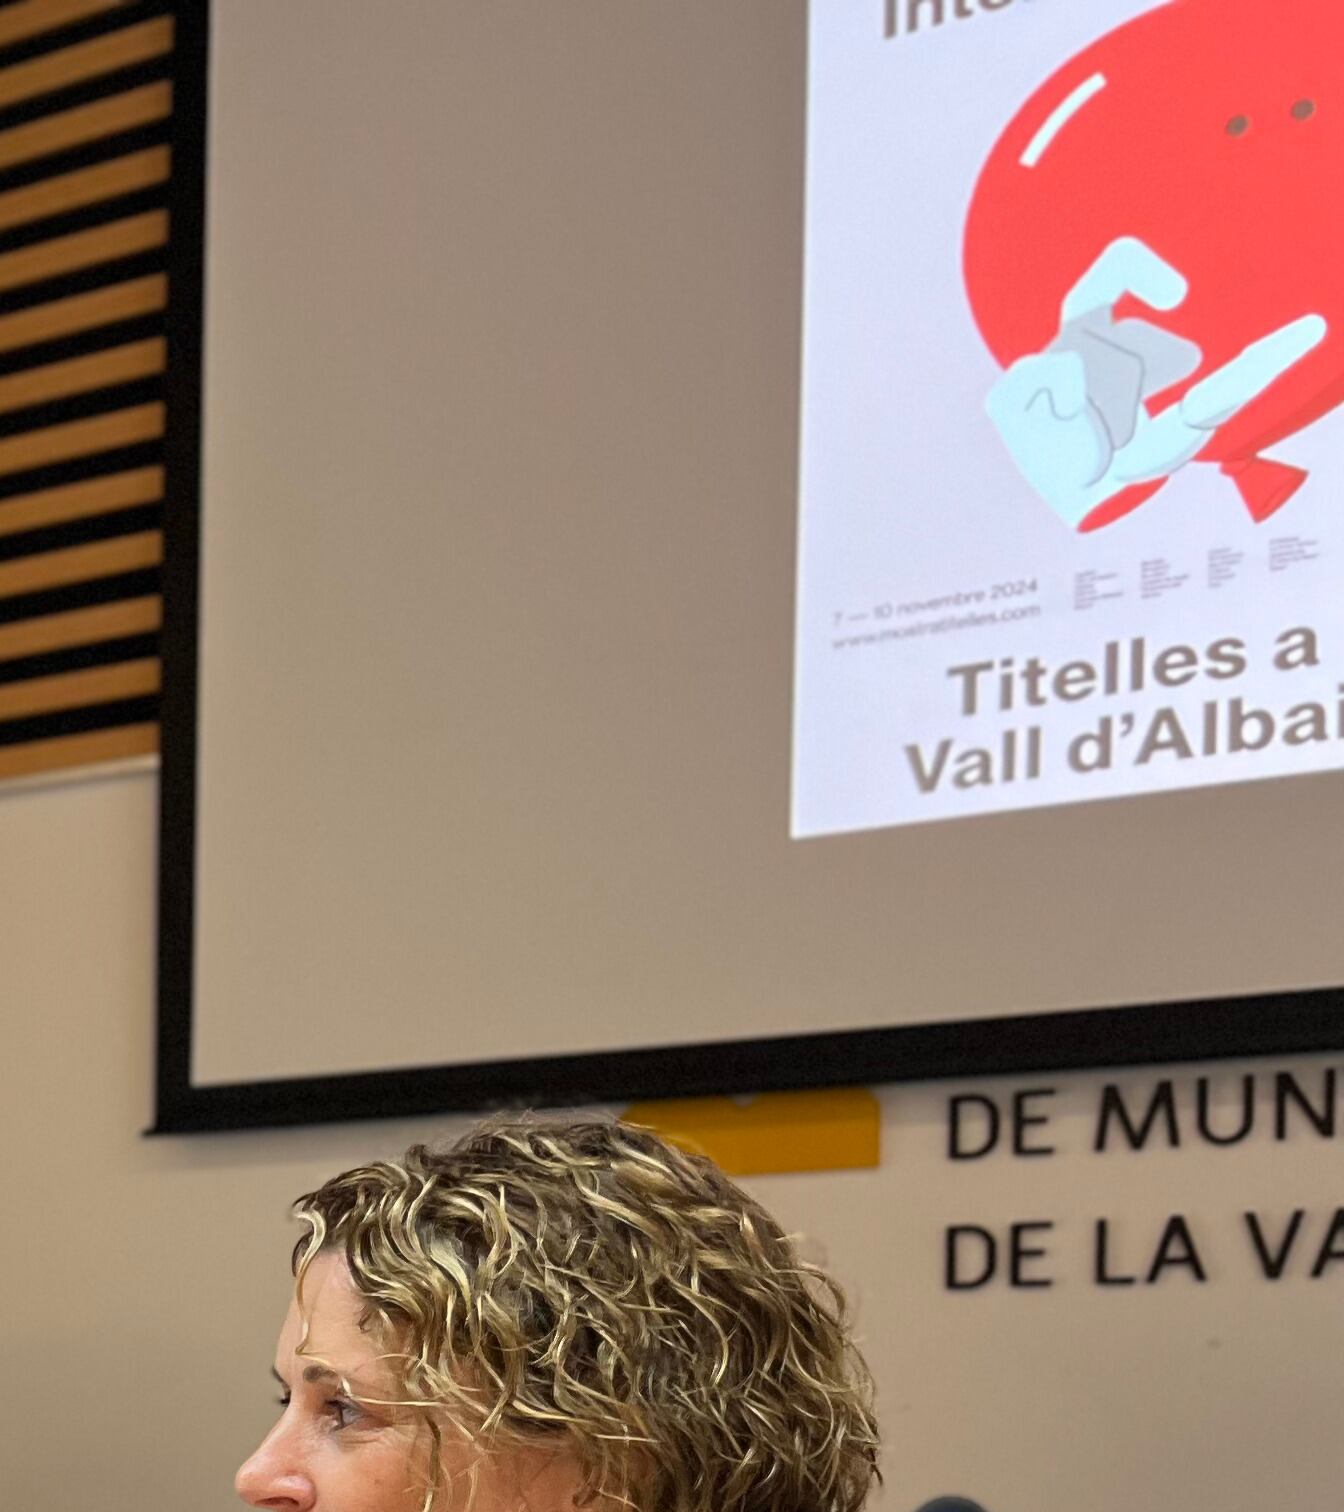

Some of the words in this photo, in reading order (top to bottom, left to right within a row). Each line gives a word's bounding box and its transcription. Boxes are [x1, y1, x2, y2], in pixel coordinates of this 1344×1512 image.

[874, 602, 893, 620] 10
[896, 588, 986, 616] novembre
[990, 577, 1038, 601] 2024
[946, 636, 1247, 716] Titelles
[1272, 626, 1320, 672] a
[904, 725, 1042, 794] Vall
[948, 1088, 1056, 1160] DE
[1094, 1067, 1337, 1153] MUN
[945, 1220, 1054, 1291] DE
[1094, 1215, 1207, 1286] LA
